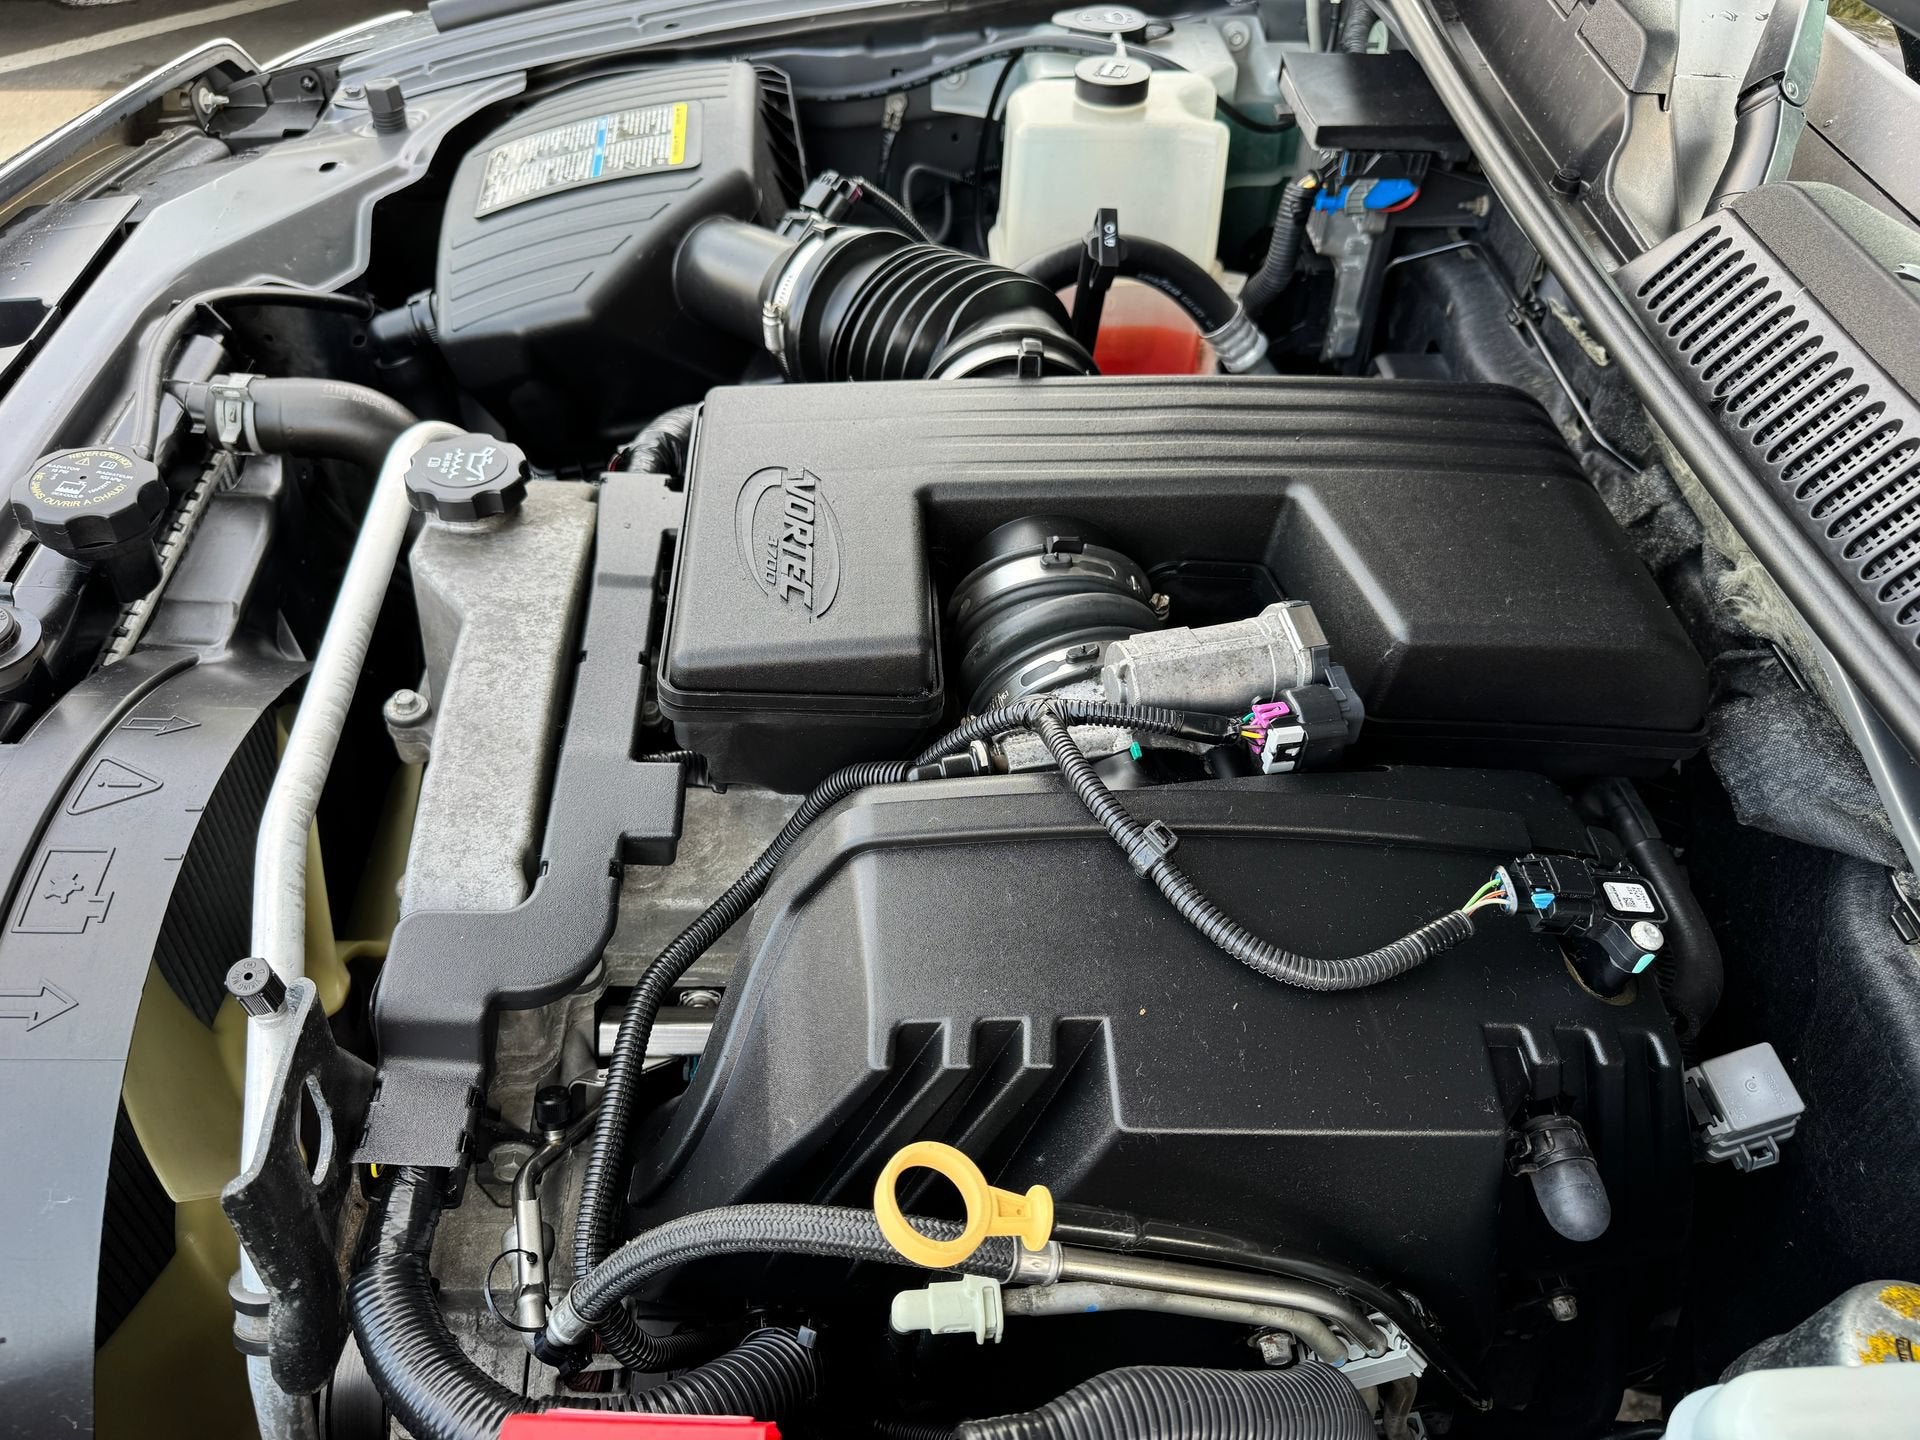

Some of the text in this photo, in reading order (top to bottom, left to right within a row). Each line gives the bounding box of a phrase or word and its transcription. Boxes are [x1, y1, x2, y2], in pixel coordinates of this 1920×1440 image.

[68, 450, 99, 459] NEVER
[43, 497, 81, 507] OUVRIR
[779, 467, 822, 612] VORTEC
[764, 535, 779, 586] 3700
